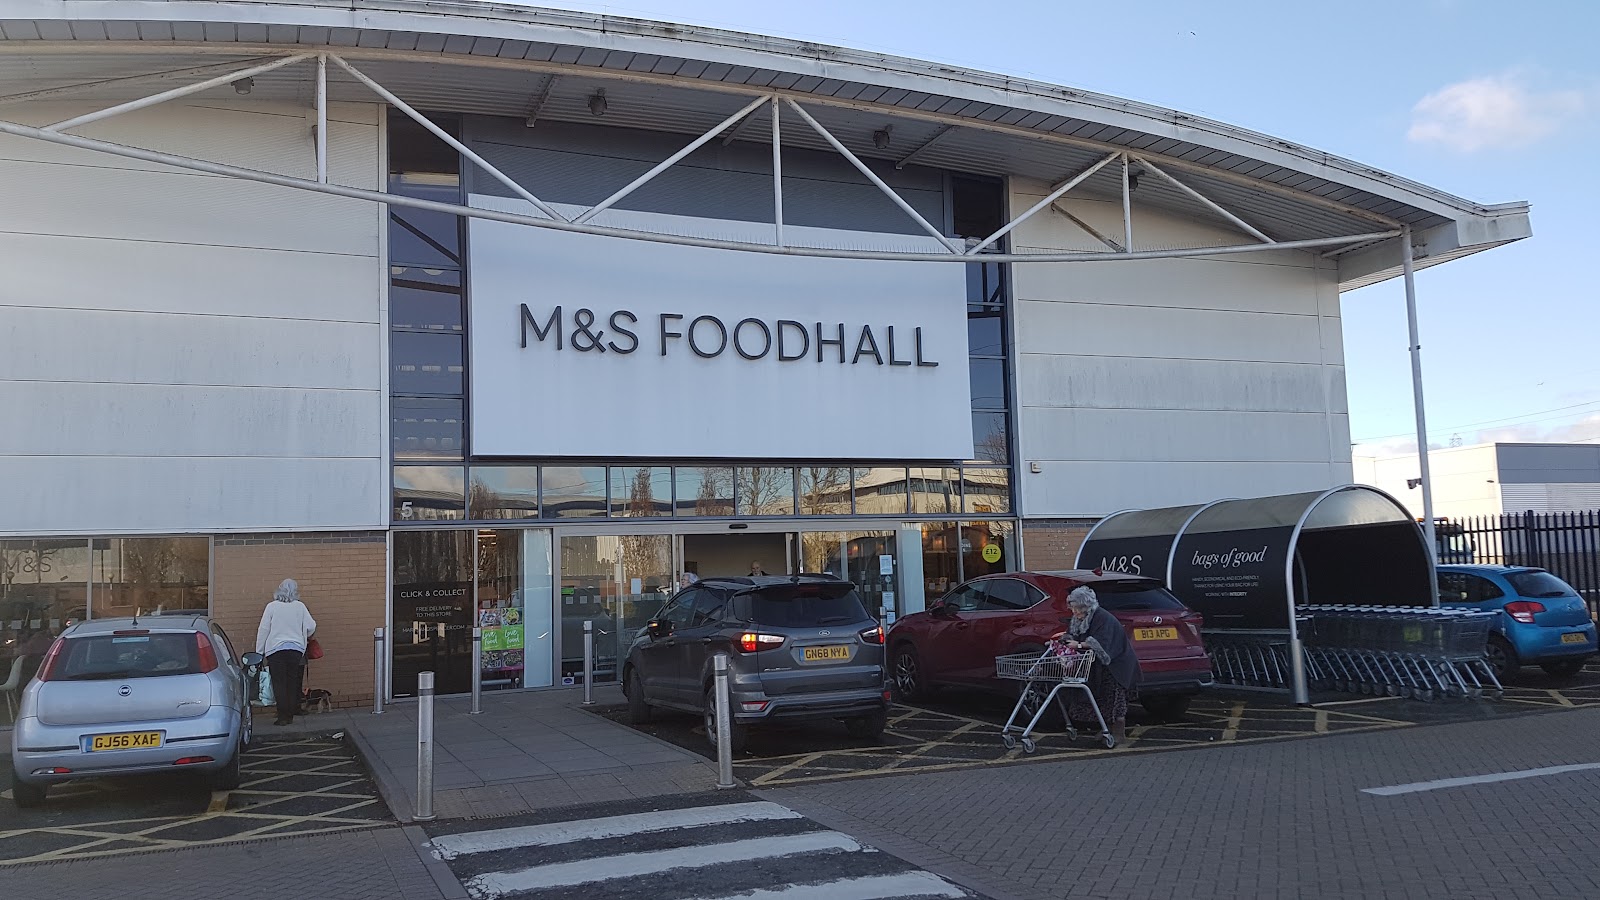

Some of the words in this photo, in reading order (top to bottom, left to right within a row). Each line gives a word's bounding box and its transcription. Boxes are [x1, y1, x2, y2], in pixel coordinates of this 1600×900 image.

[520, 303, 639, 354] M&S
[660, 313, 939, 367] FOODHALL
[401, 501, 413, 518] 5
[1101, 554, 1142, 576] M&S
[1191, 550, 1220, 569] bags
[1220, 547, 1238, 568] of
[1232, 545, 1268, 568] good
[400, 590, 423, 598] CLICK
[433, 588, 467, 597] COLLECT
[805, 648, 829, 659] GN68
[830, 647, 848, 657] NYA
[95, 735, 129, 749] GJ56
[132, 733, 159, 746] XAF
